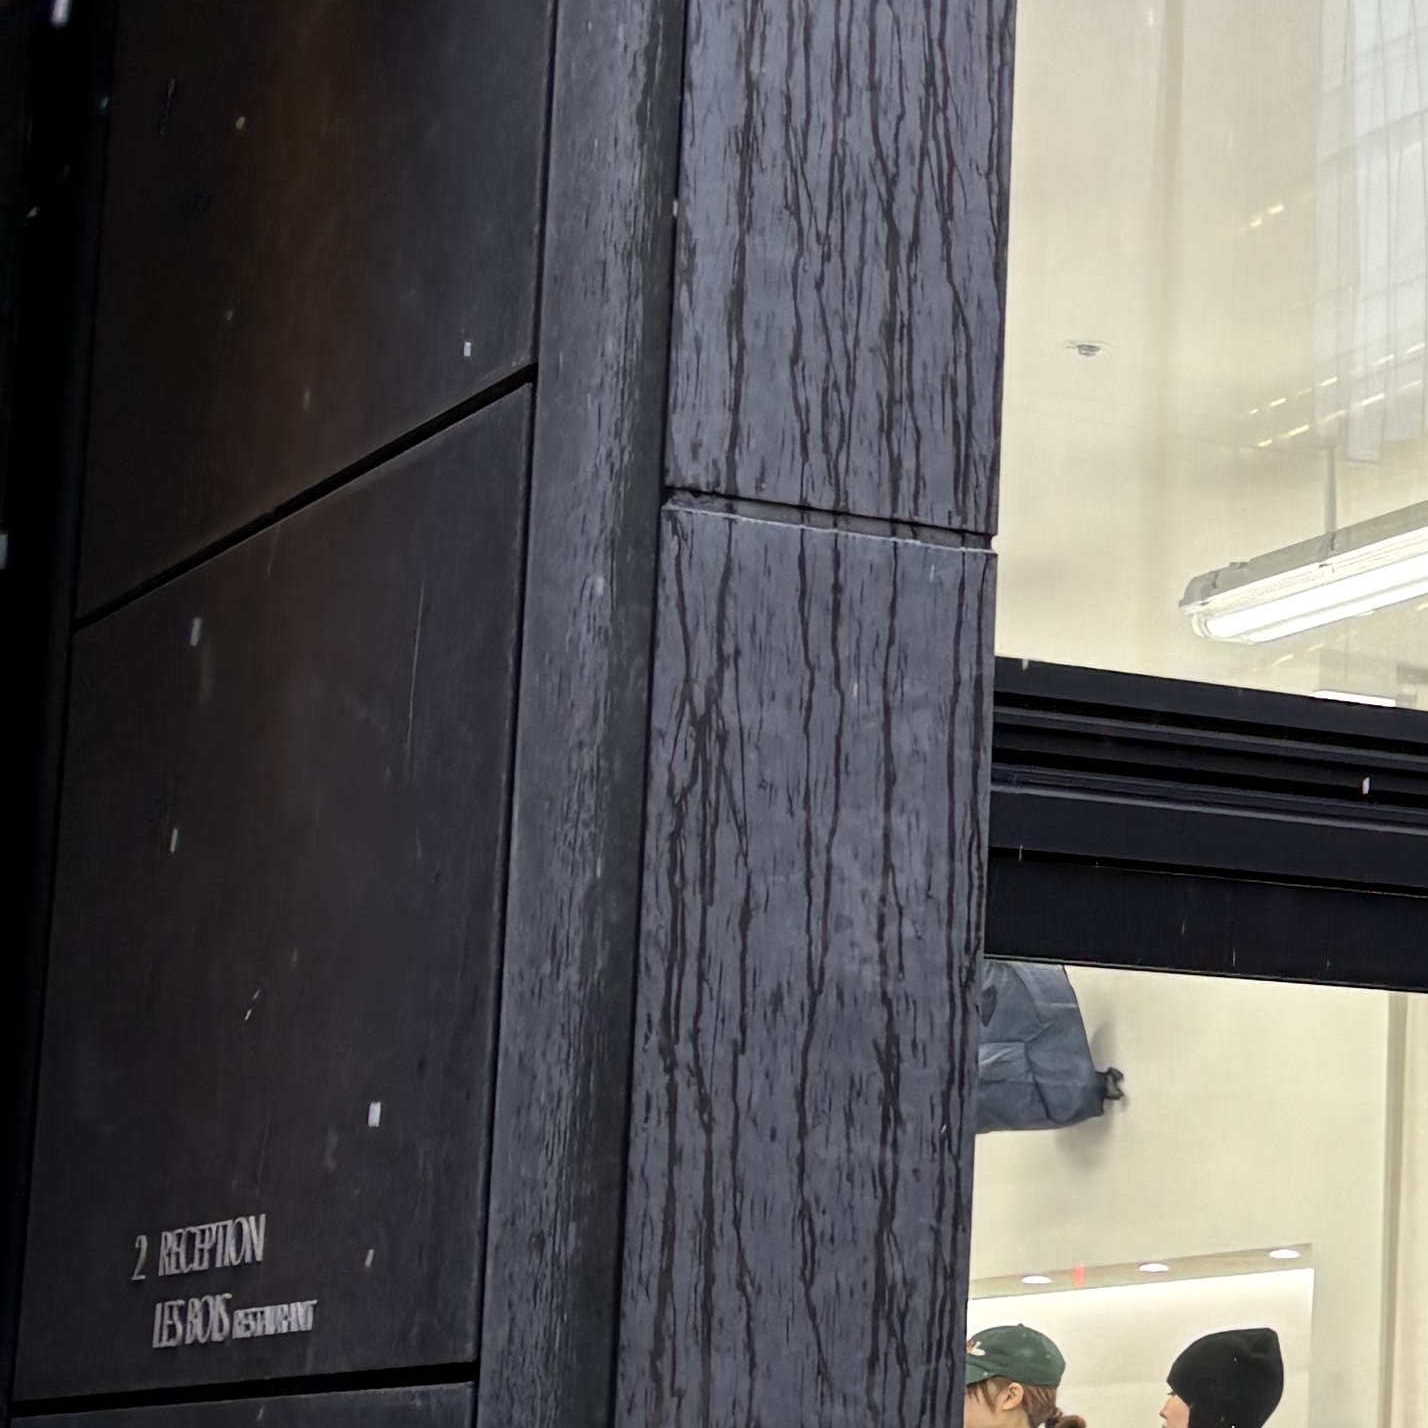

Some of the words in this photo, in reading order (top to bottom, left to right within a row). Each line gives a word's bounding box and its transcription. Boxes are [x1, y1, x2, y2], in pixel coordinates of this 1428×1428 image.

[132, 1235, 148, 1281] 2
[158, 1213, 266, 1277] RECEPTION
[152, 1299, 185, 1348] LES
[186, 1292, 232, 1345] BOIS
